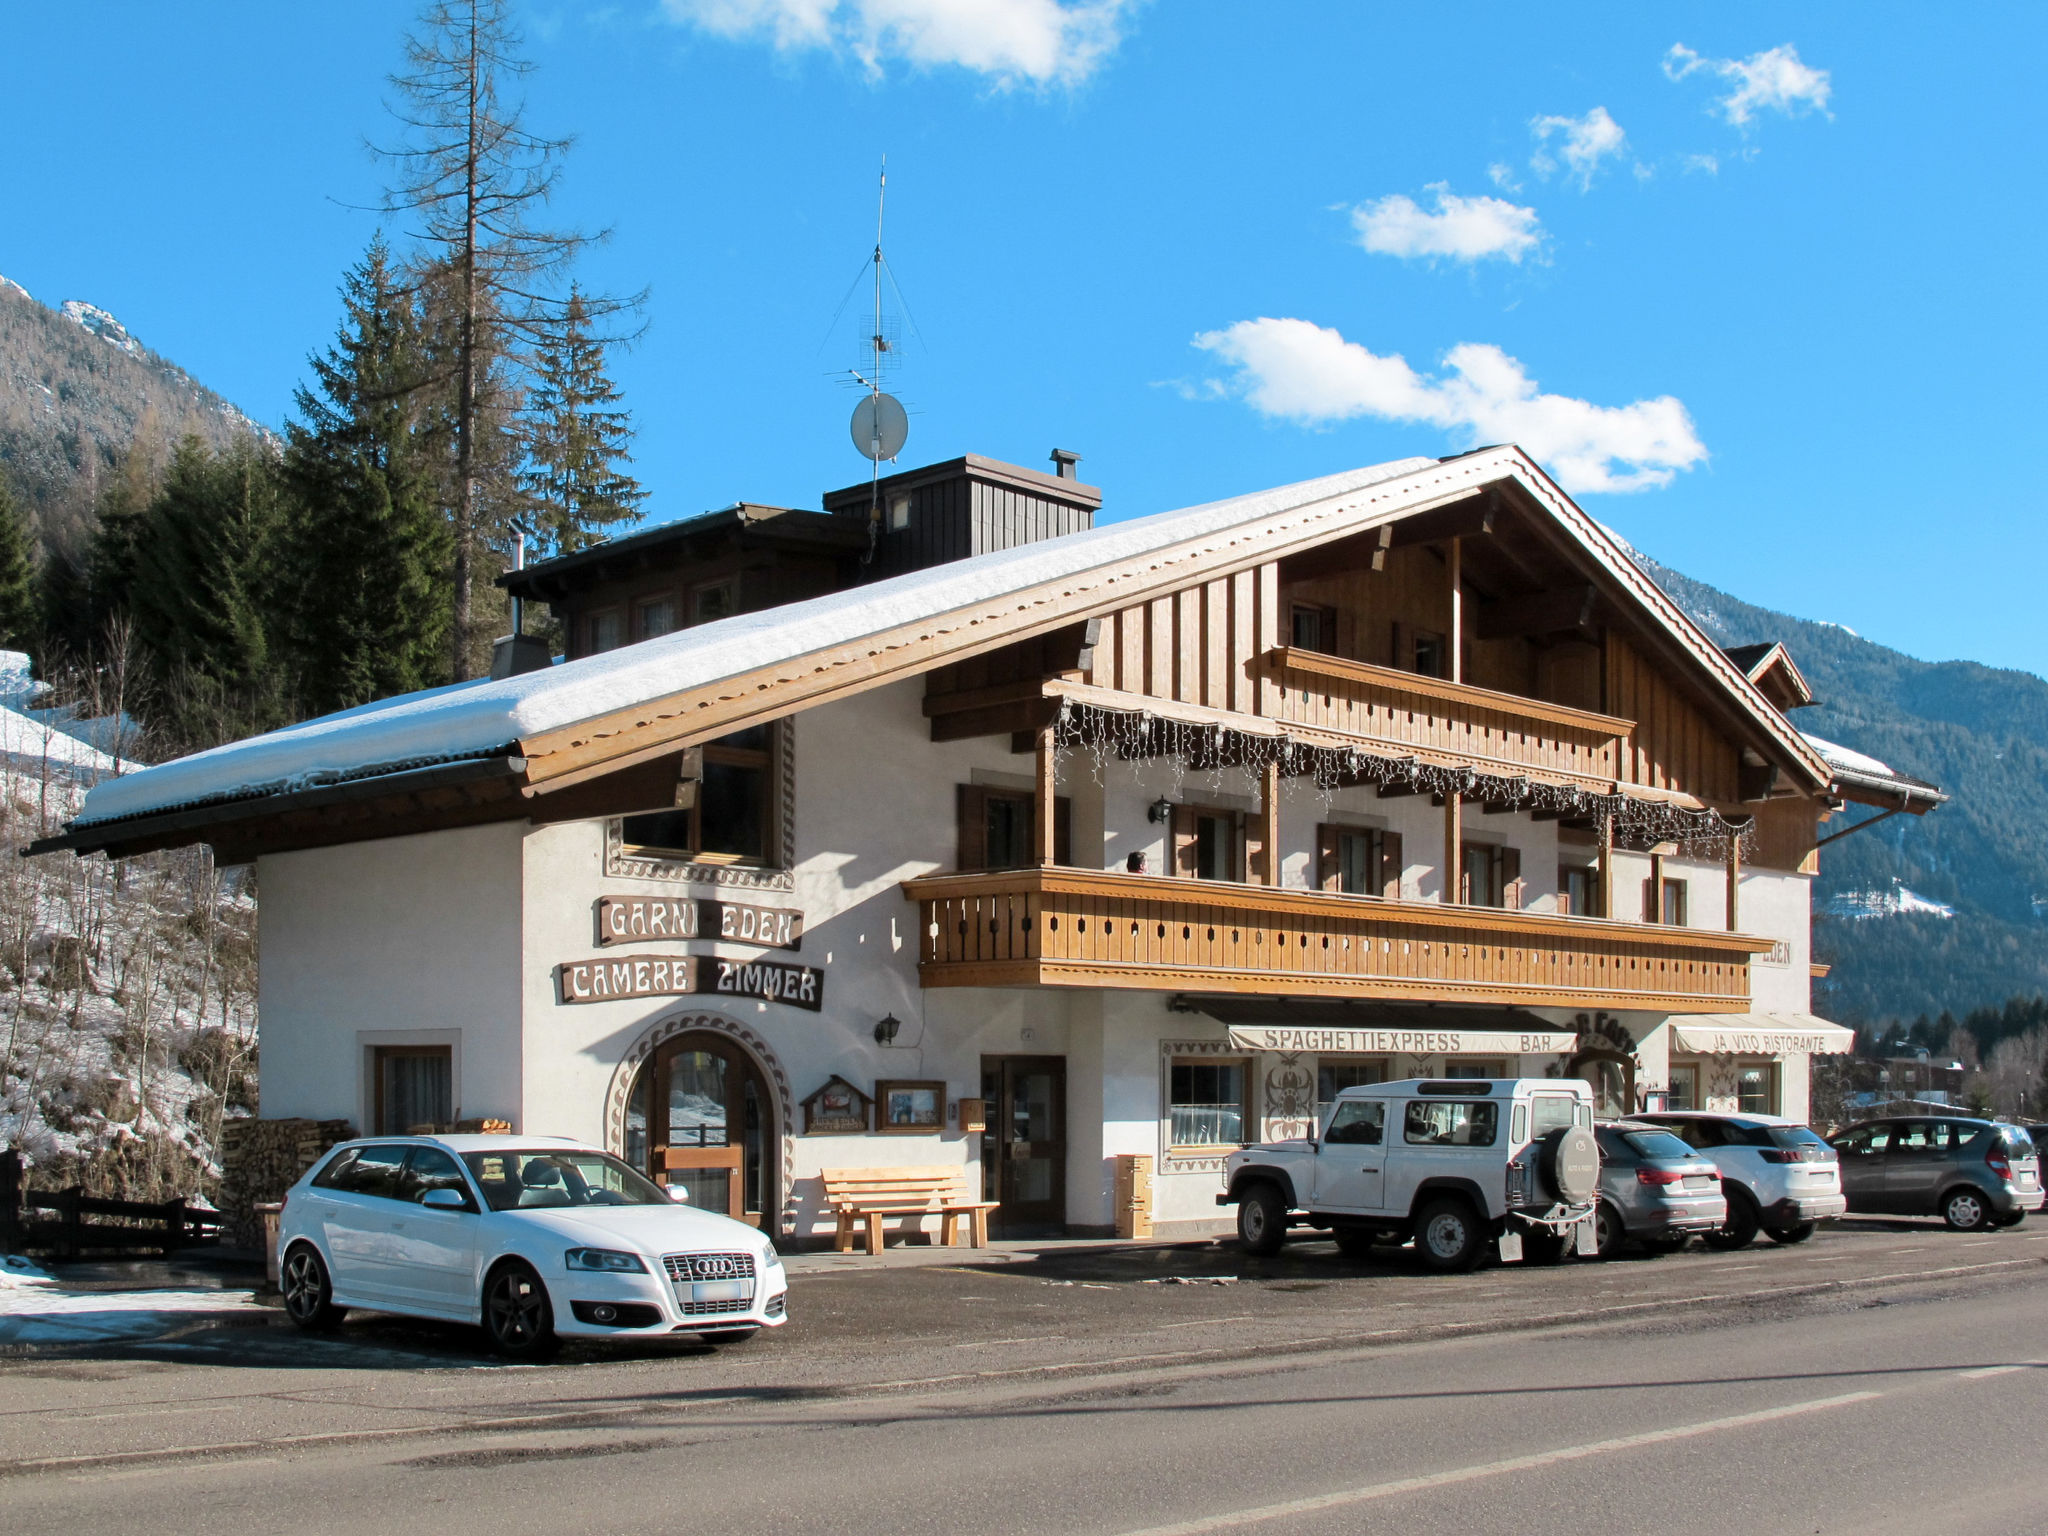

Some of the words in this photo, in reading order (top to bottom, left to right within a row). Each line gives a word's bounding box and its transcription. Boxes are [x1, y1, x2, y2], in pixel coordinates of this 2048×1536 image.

[610, 903, 699, 936] GARNI
[720, 906, 793, 945] EDEN
[572, 961, 688, 997] CAMERE
[717, 962, 817, 1002] ZIMMER
[1264, 1030, 1461, 1051] SPAGHETTIEXPRESS
[1520, 1035, 1551, 1052] BAR
[1732, 1034, 1760, 1050] VITO
[1763, 1036, 1825, 1051] RISTORANTE
